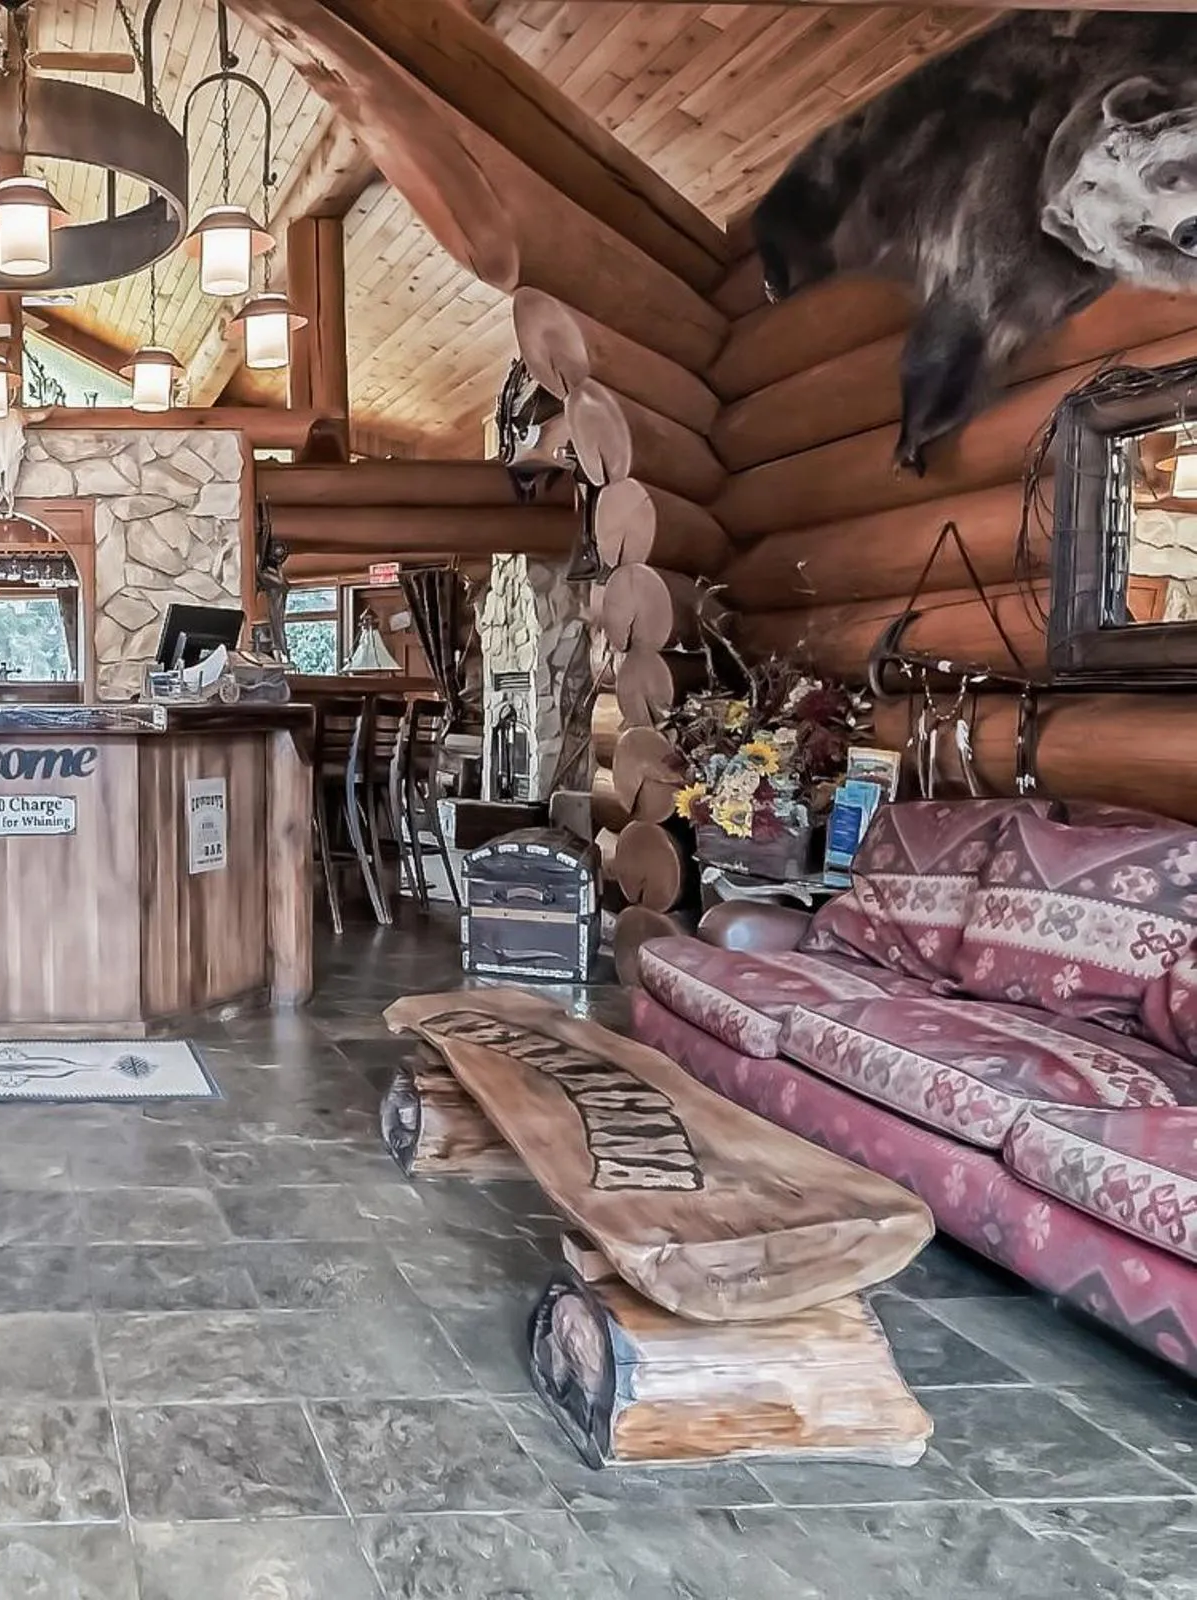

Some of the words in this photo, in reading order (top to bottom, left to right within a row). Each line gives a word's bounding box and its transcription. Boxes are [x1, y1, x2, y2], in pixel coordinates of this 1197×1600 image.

[9, 797, 62, 816] Charge
[2, 816, 18, 828] for
[21, 815, 71, 830] Whining
